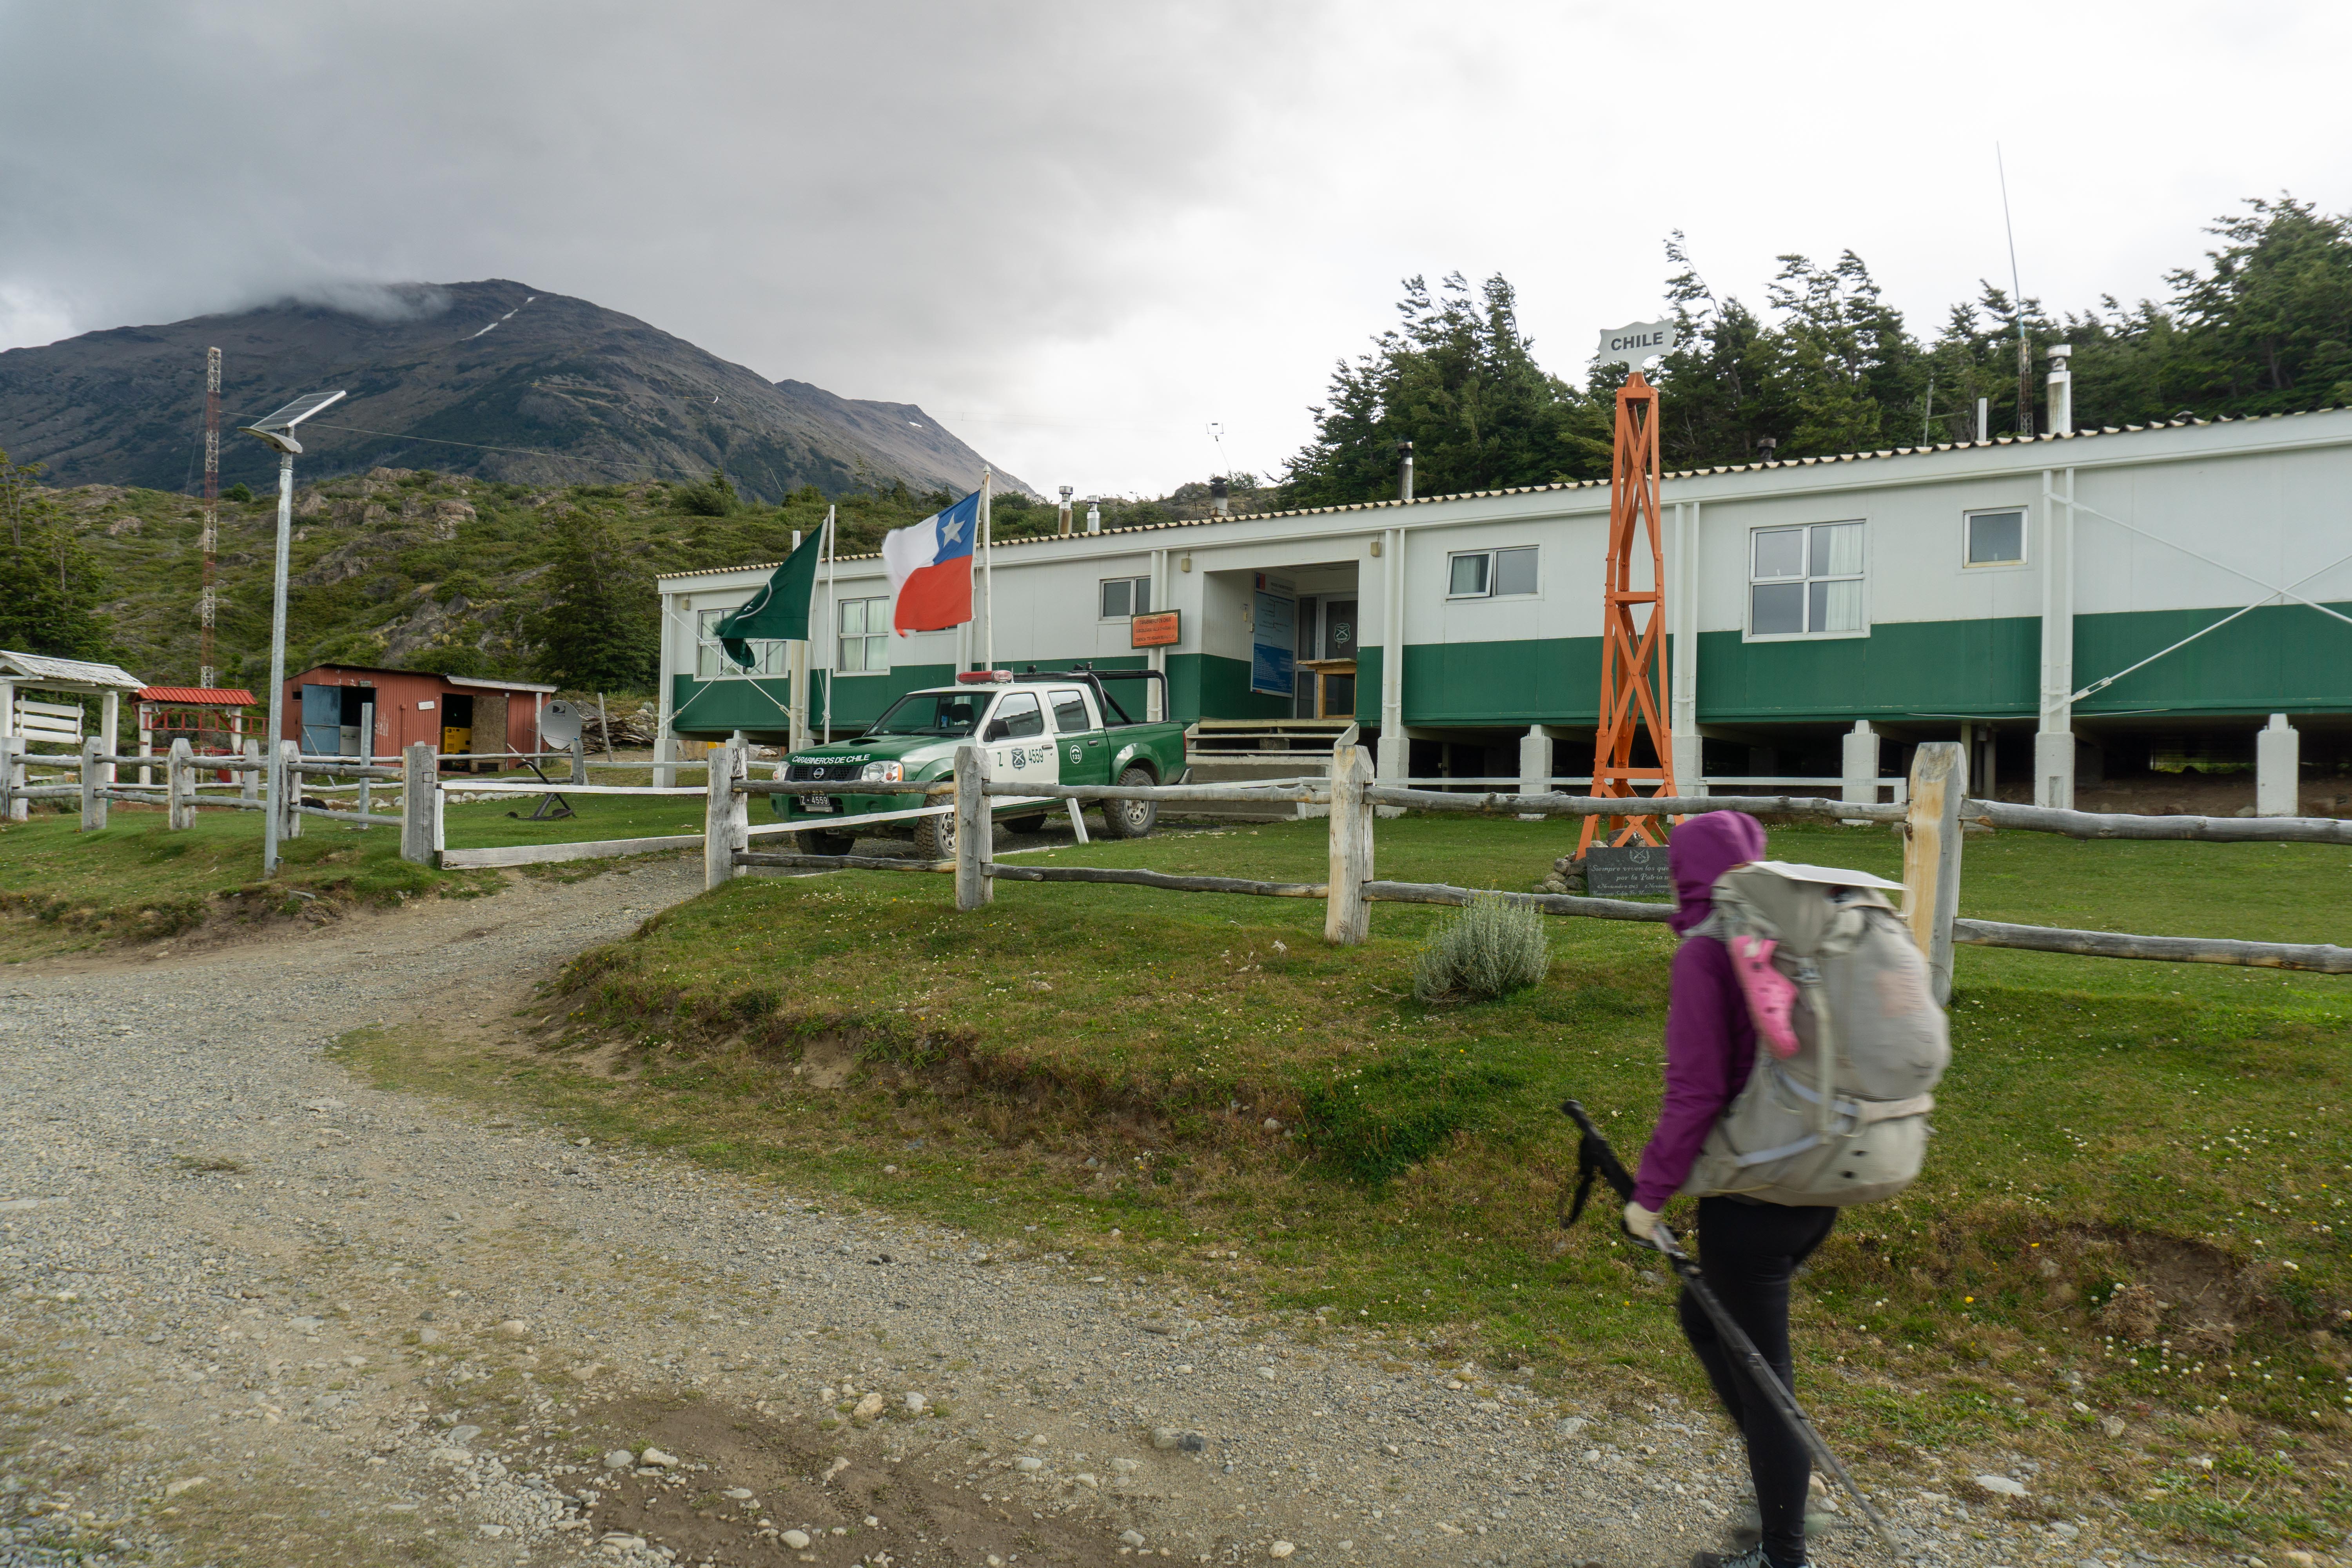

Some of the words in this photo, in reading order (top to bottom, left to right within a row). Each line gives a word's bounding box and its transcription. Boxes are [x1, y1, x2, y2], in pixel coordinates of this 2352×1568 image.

[1611, 332, 1663, 350] CHILE
[792, 756, 834, 764] CARABINEROS
[846, 754, 870, 762] CHILE
[997, 752, 1003, 767] Z
[1029, 748, 1043, 764] 4559
